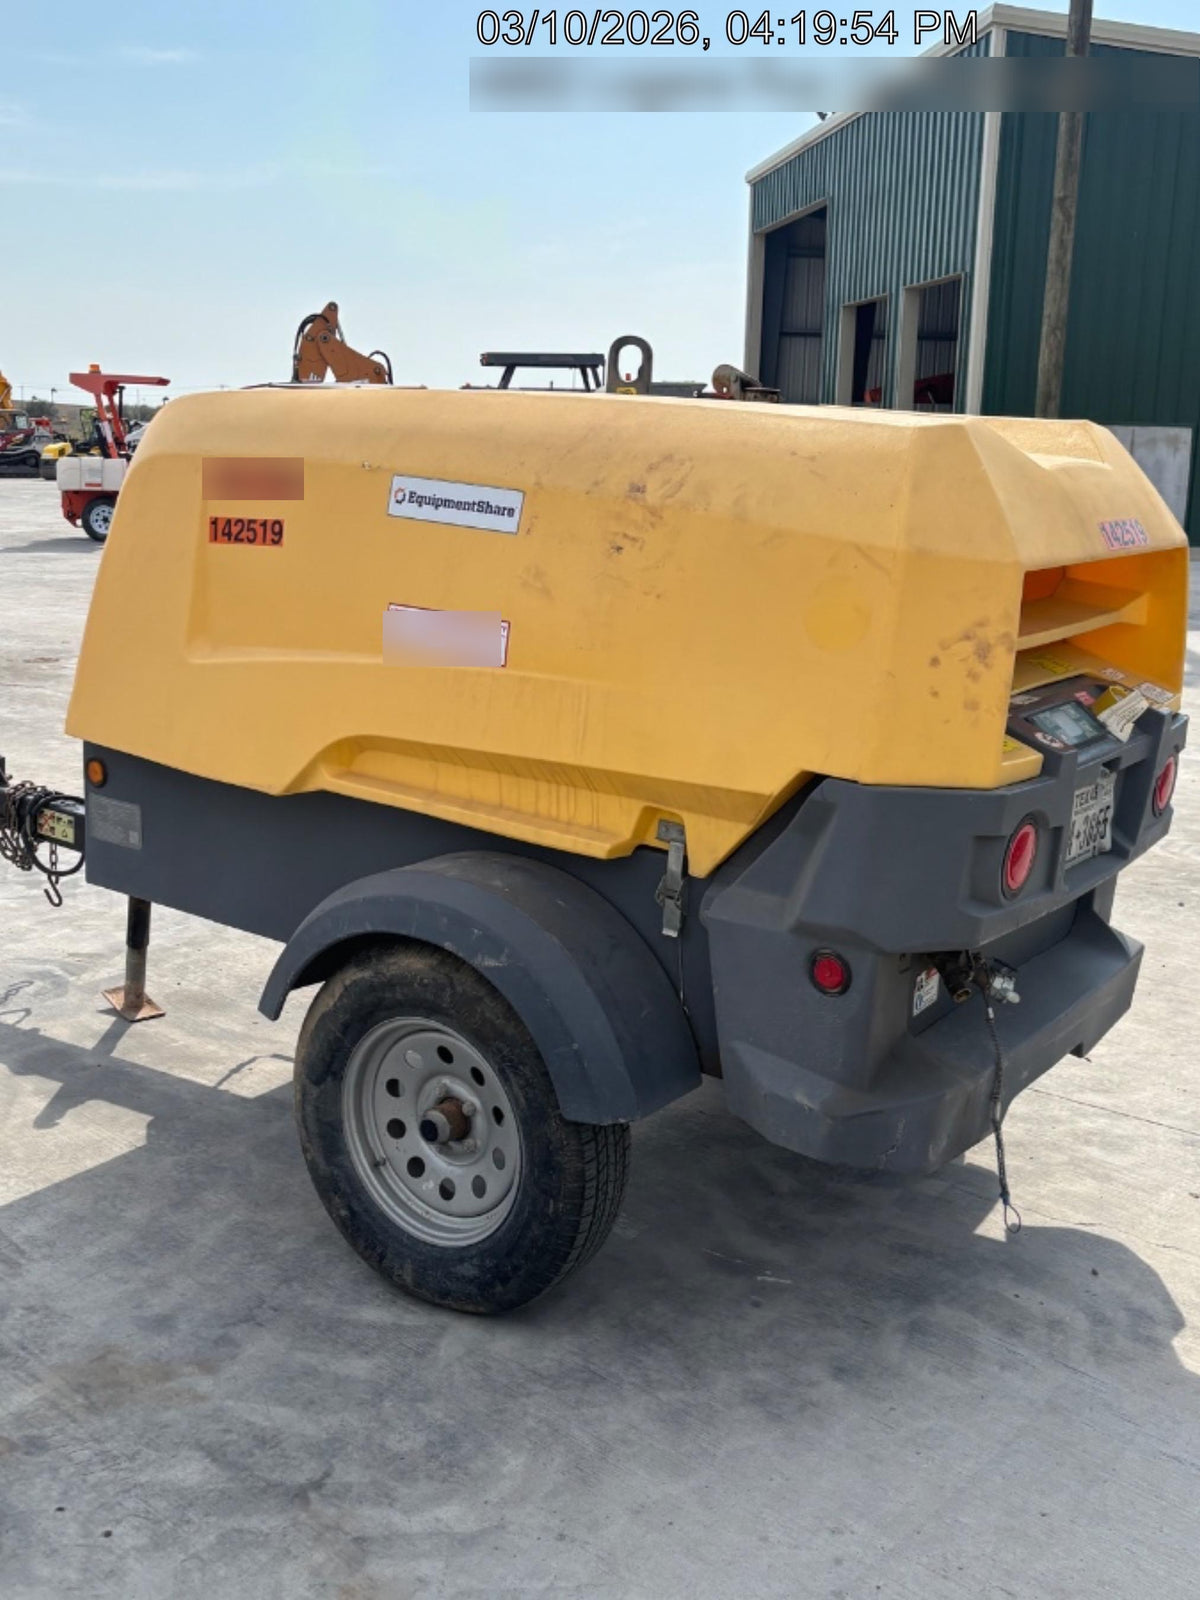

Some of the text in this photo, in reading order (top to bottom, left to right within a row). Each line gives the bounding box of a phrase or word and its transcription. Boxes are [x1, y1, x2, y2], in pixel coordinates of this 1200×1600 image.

[408, 490, 516, 518] EquipmentShare
[210, 516, 283, 544] 142519
[1098, 519, 1148, 548] 142519
